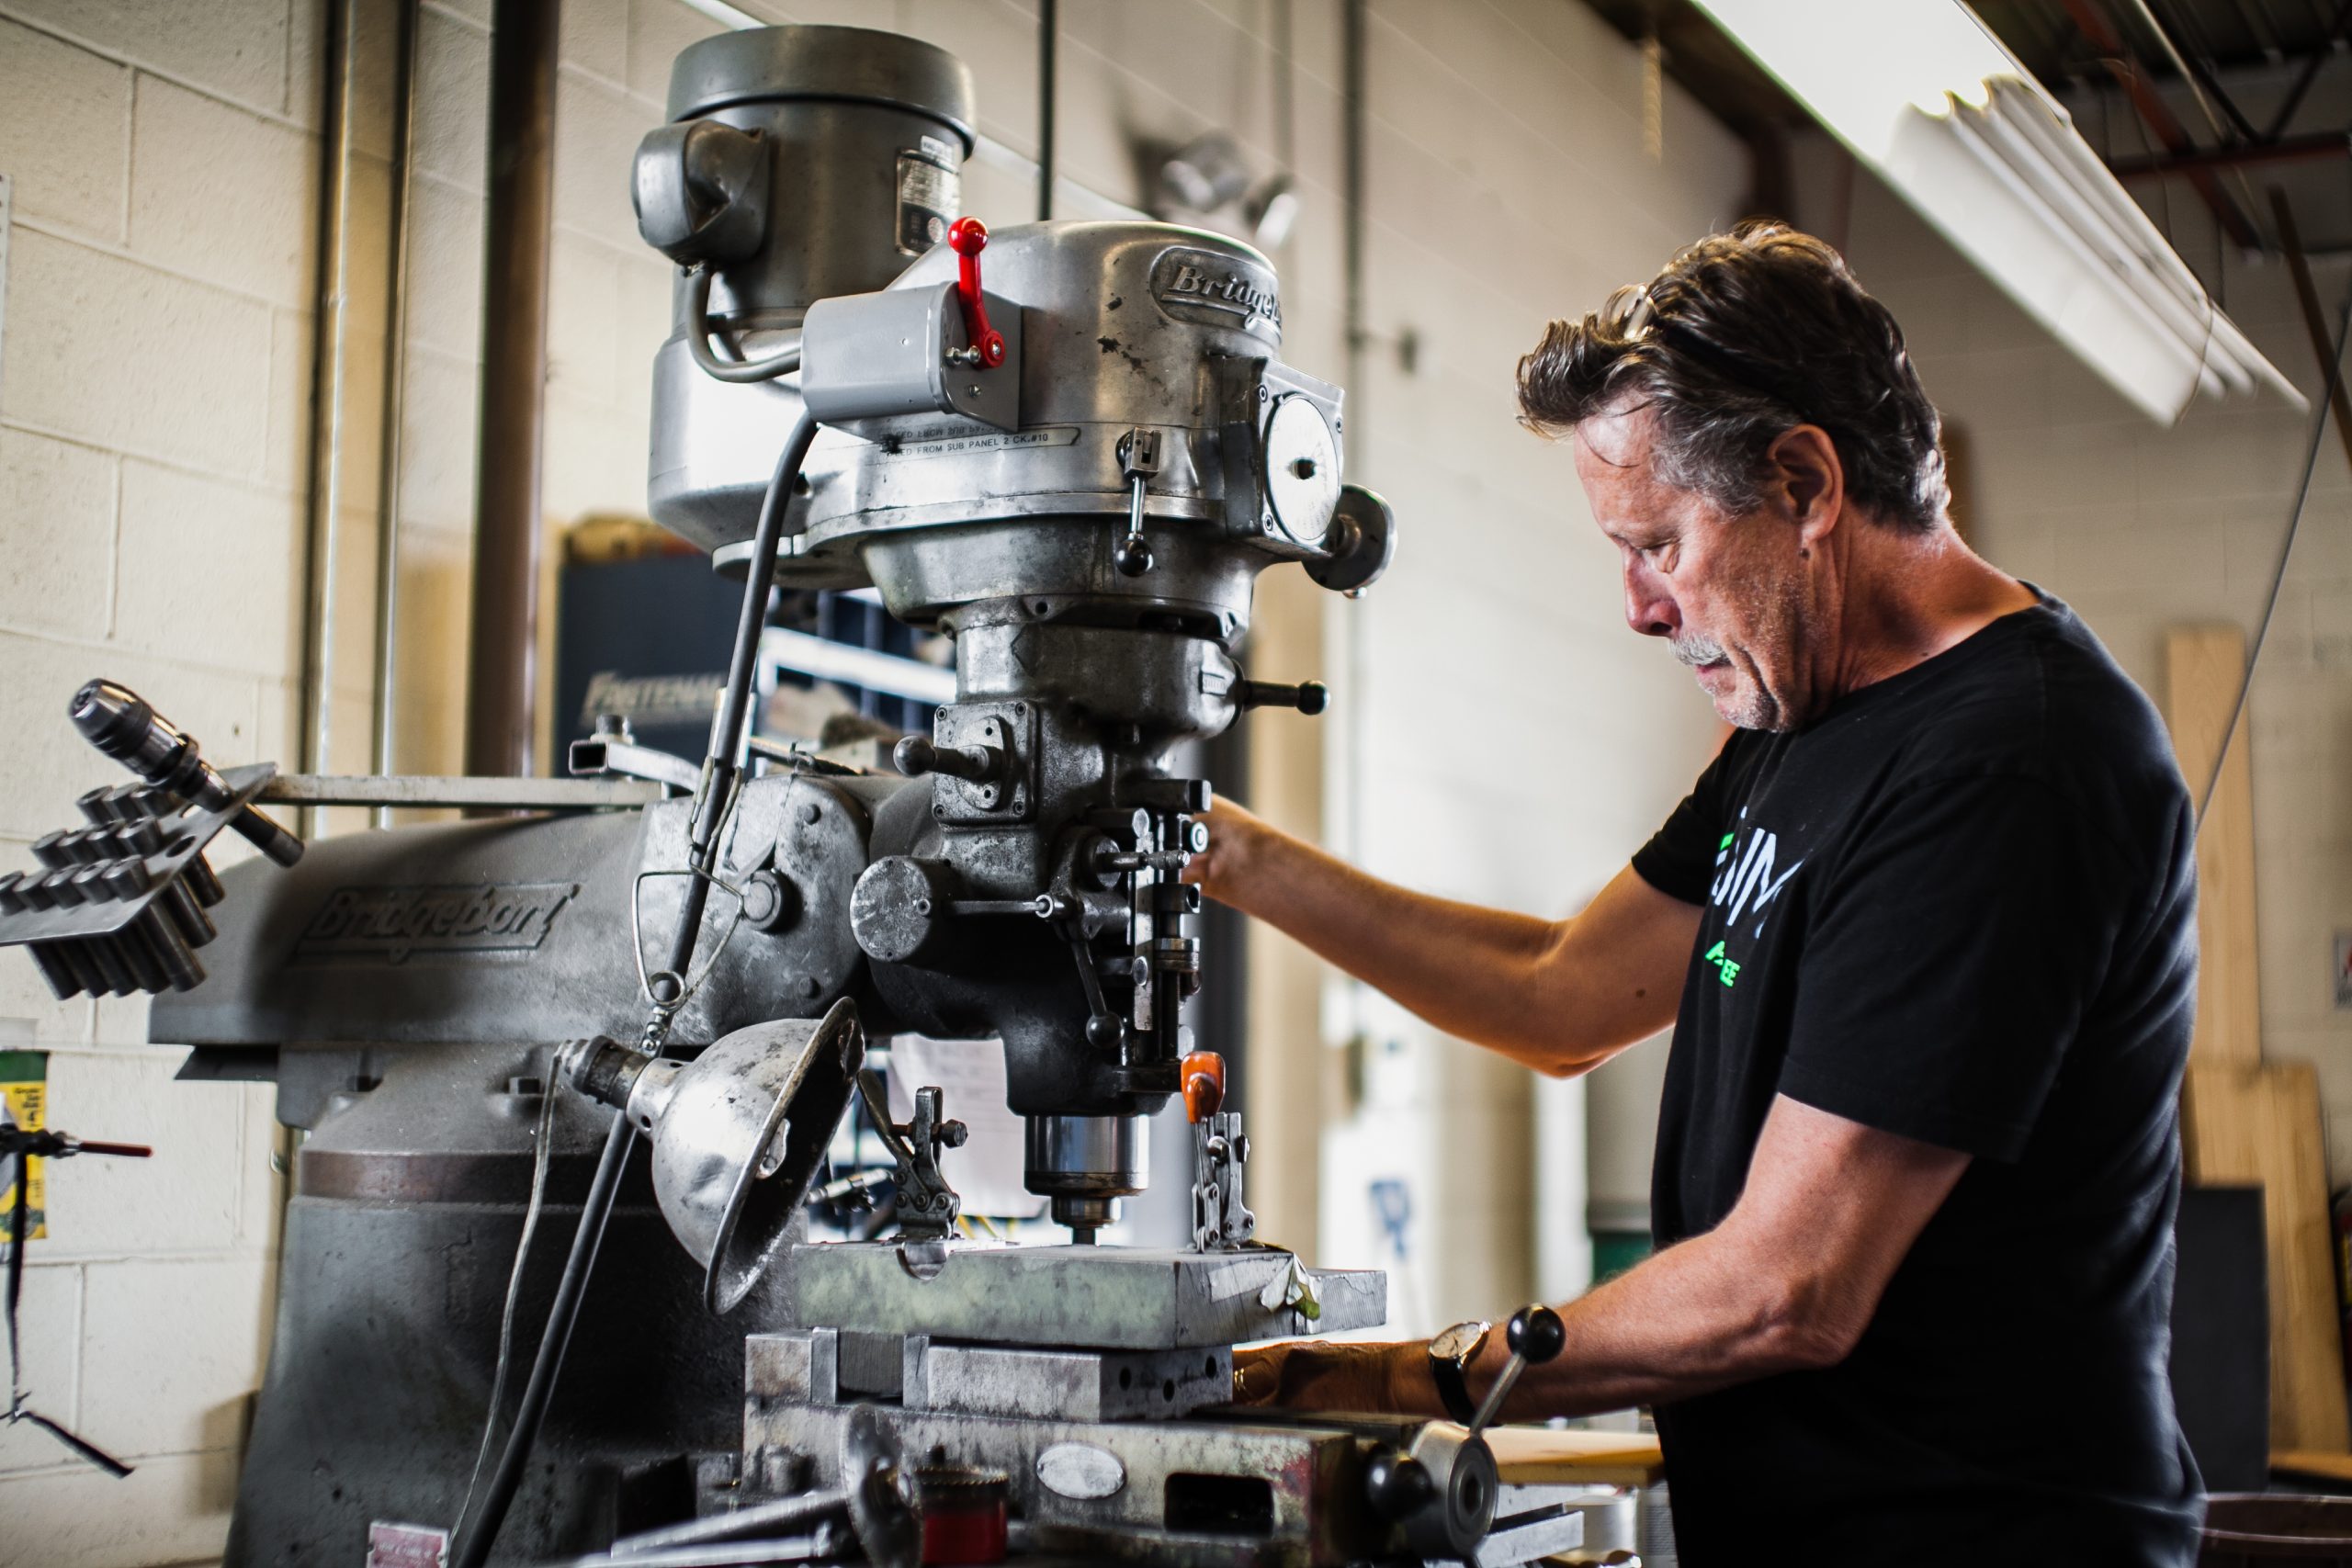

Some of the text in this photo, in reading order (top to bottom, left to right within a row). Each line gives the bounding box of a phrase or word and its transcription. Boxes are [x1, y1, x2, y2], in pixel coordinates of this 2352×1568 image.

[918, 444, 943, 456] FROM
[947, 441, 965, 453] SUB
[968, 438, 999, 449] PANEL
[1003, 435, 1010, 446] 2
